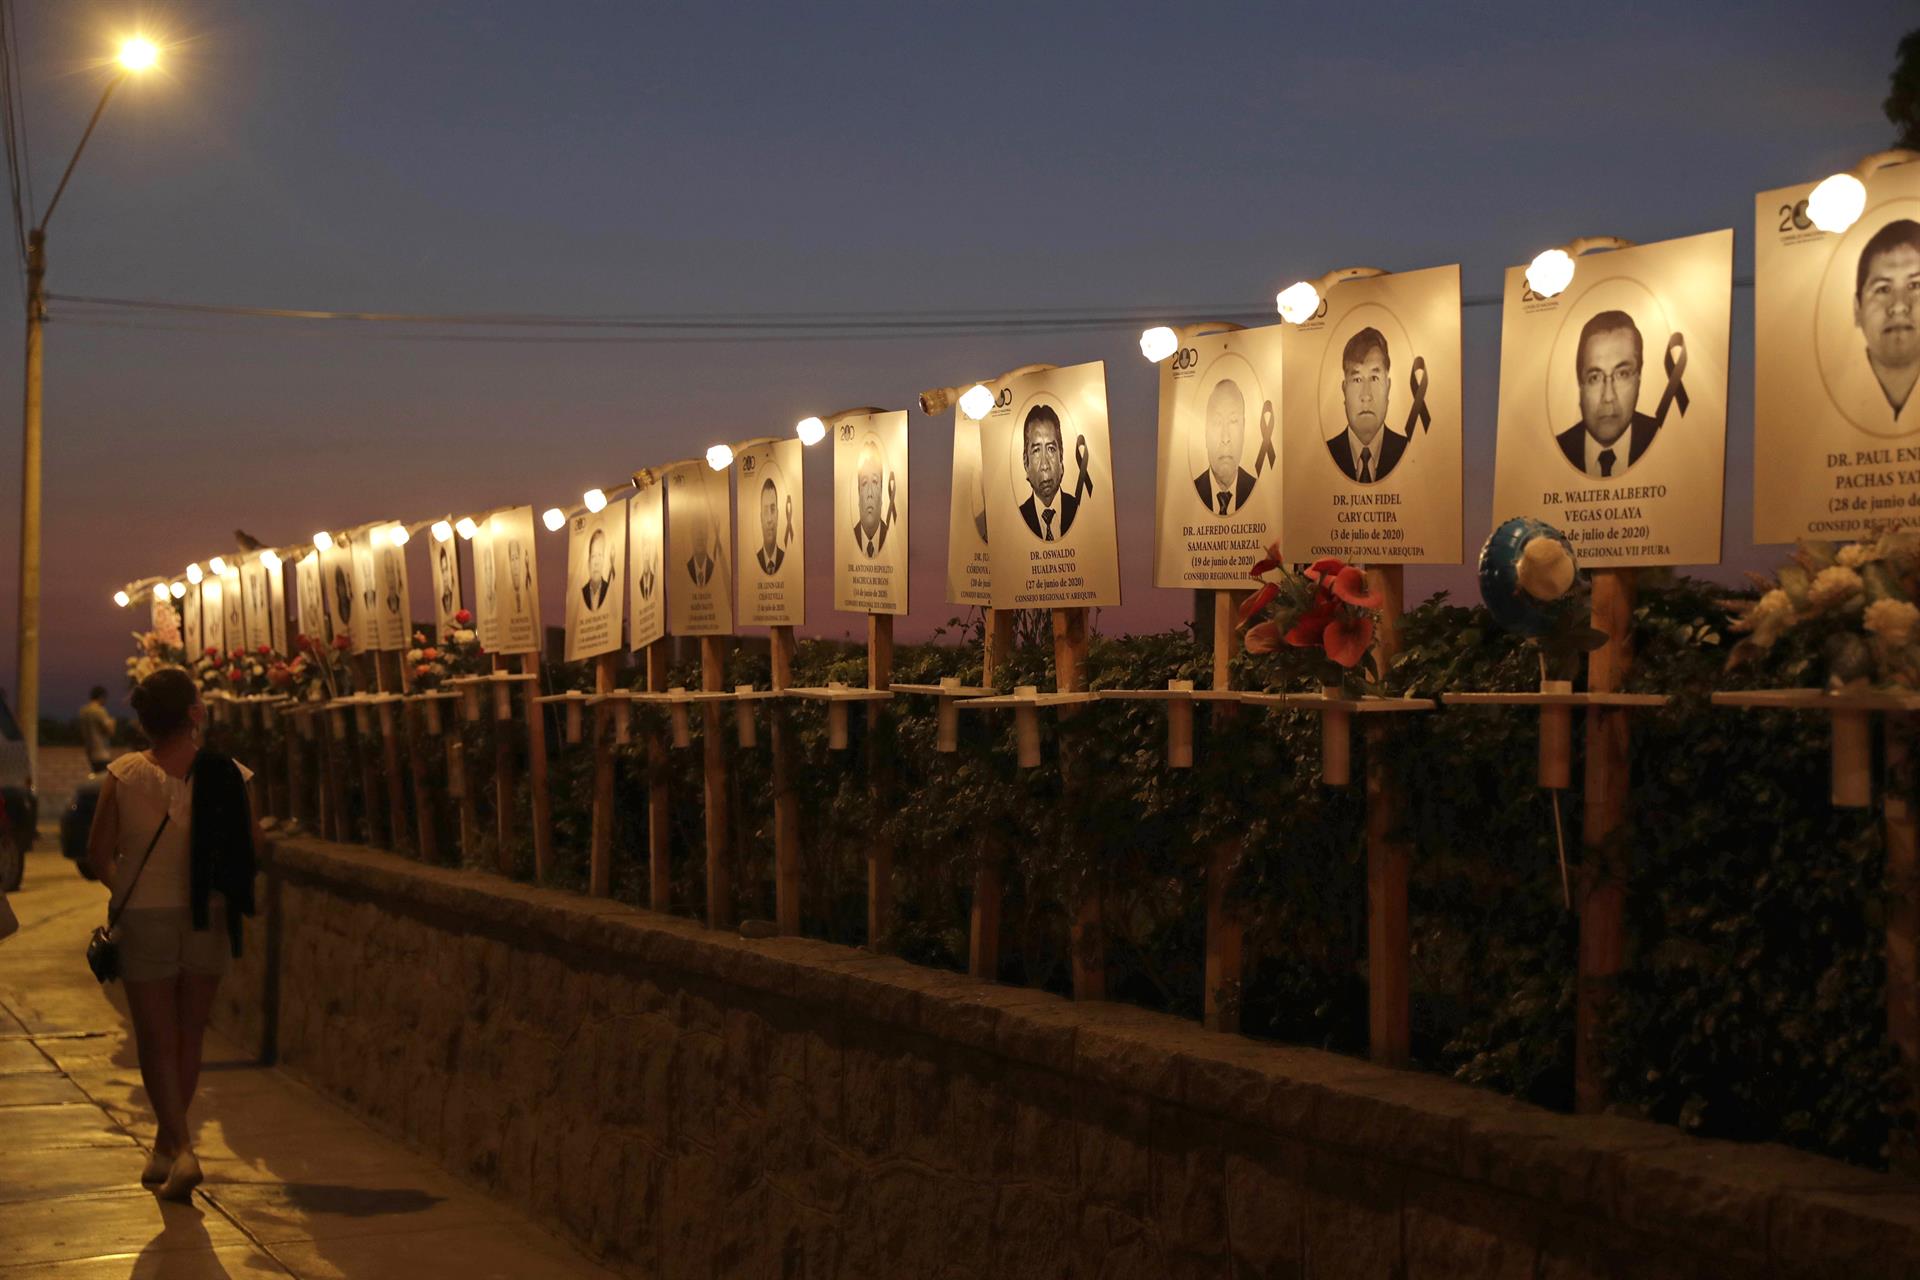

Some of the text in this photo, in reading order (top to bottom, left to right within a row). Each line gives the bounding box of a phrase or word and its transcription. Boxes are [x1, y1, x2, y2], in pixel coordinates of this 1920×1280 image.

[1172, 348, 1198, 370] 200
[1827, 453, 1852, 468] DR.
[1856, 449, 1893, 465] PAUL
[1836, 472, 1895, 489] PACHAS
[1333, 493, 1402, 507] DR. JUAN FIDEL
[1543, 485, 1667, 505] DR. WALTER ALBERTO
[1828, 498, 1849, 514] (28
[1852, 495, 1867, 510] de
[1870, 494, 1904, 514] junio
[1337, 511, 1397, 523] CARY CUTIPA
[1565, 507, 1642, 523] VEGAS OLAYA
[1183, 523, 1266, 536] DR. ALFREDO GLICERIO
[1808, 519, 1860, 533] CONSEJO
[1330, 528, 1404, 541] (3 de julio de 2020)
[1568, 529, 1580, 542] de
[1581, 528, 1605, 543] julio
[1607, 527, 1619, 540] de
[1621, 525, 1650, 541] 2020)
[1230, 539, 1261, 550] MARZAL
[1030, 548, 1075, 561] DR. OSWALDO
[1311, 546, 1343, 556] CONSEJO
[1344, 546, 1381, 556] REGIONAL
[1388, 546, 1425, 557] AREQUIPA
[1577, 544, 1670, 559] REGIONAL VII PIURA
[1202, 556, 1210, 566] de
[1211, 556, 1228, 568] junio
[1228, 555, 1237, 566] de
[1238, 555, 1256, 567] 2020)
[1031, 563, 1076, 575] HUALPA SUYO
[1183, 572, 1209, 581] CONSEJO
[1210, 571, 1239, 580] REGIONAL
[1036, 579, 1044, 589] de
[1044, 579, 1059, 590] junio
[1060, 577, 1068, 587] de
